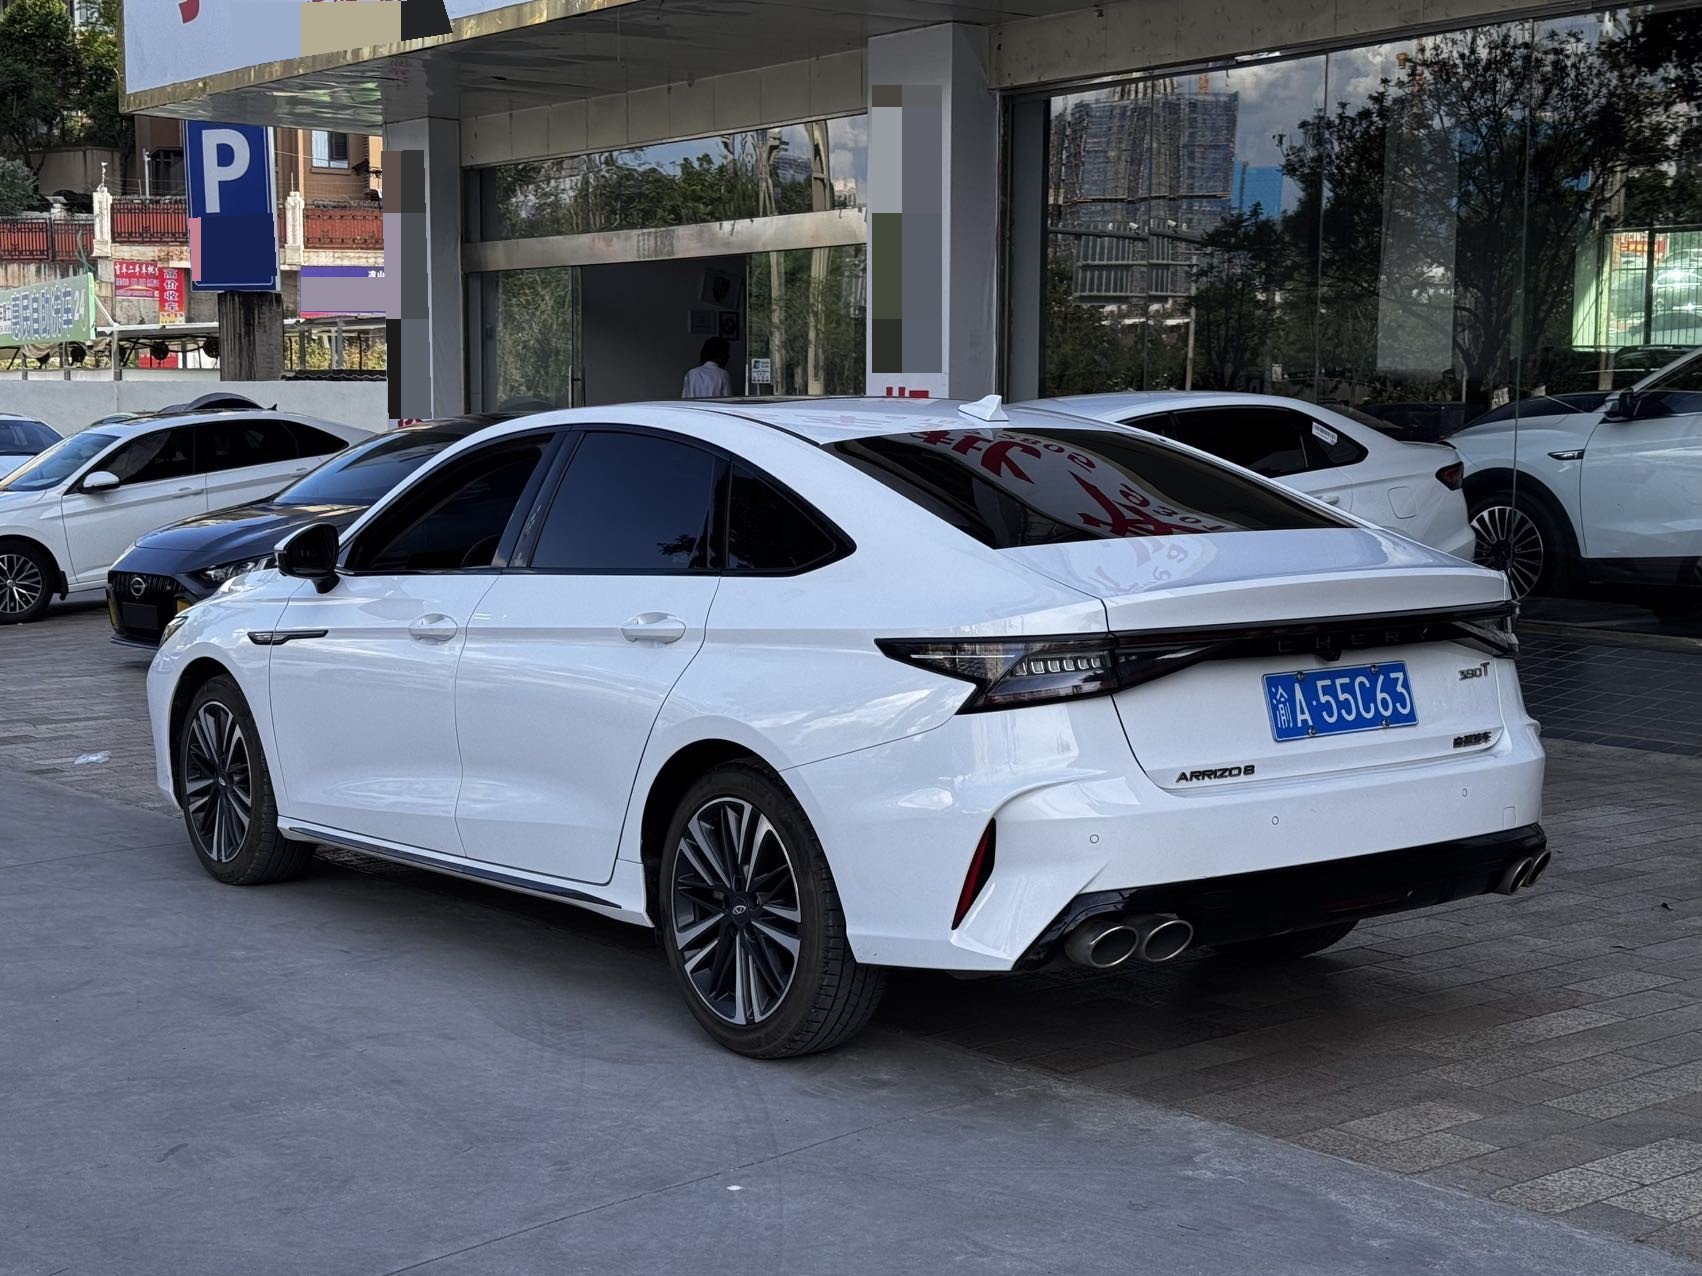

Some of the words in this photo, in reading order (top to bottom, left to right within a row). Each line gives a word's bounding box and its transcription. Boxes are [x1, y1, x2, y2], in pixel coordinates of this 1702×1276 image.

[201, 128, 251, 214] P
[163, 268, 179, 312] 高价收车
